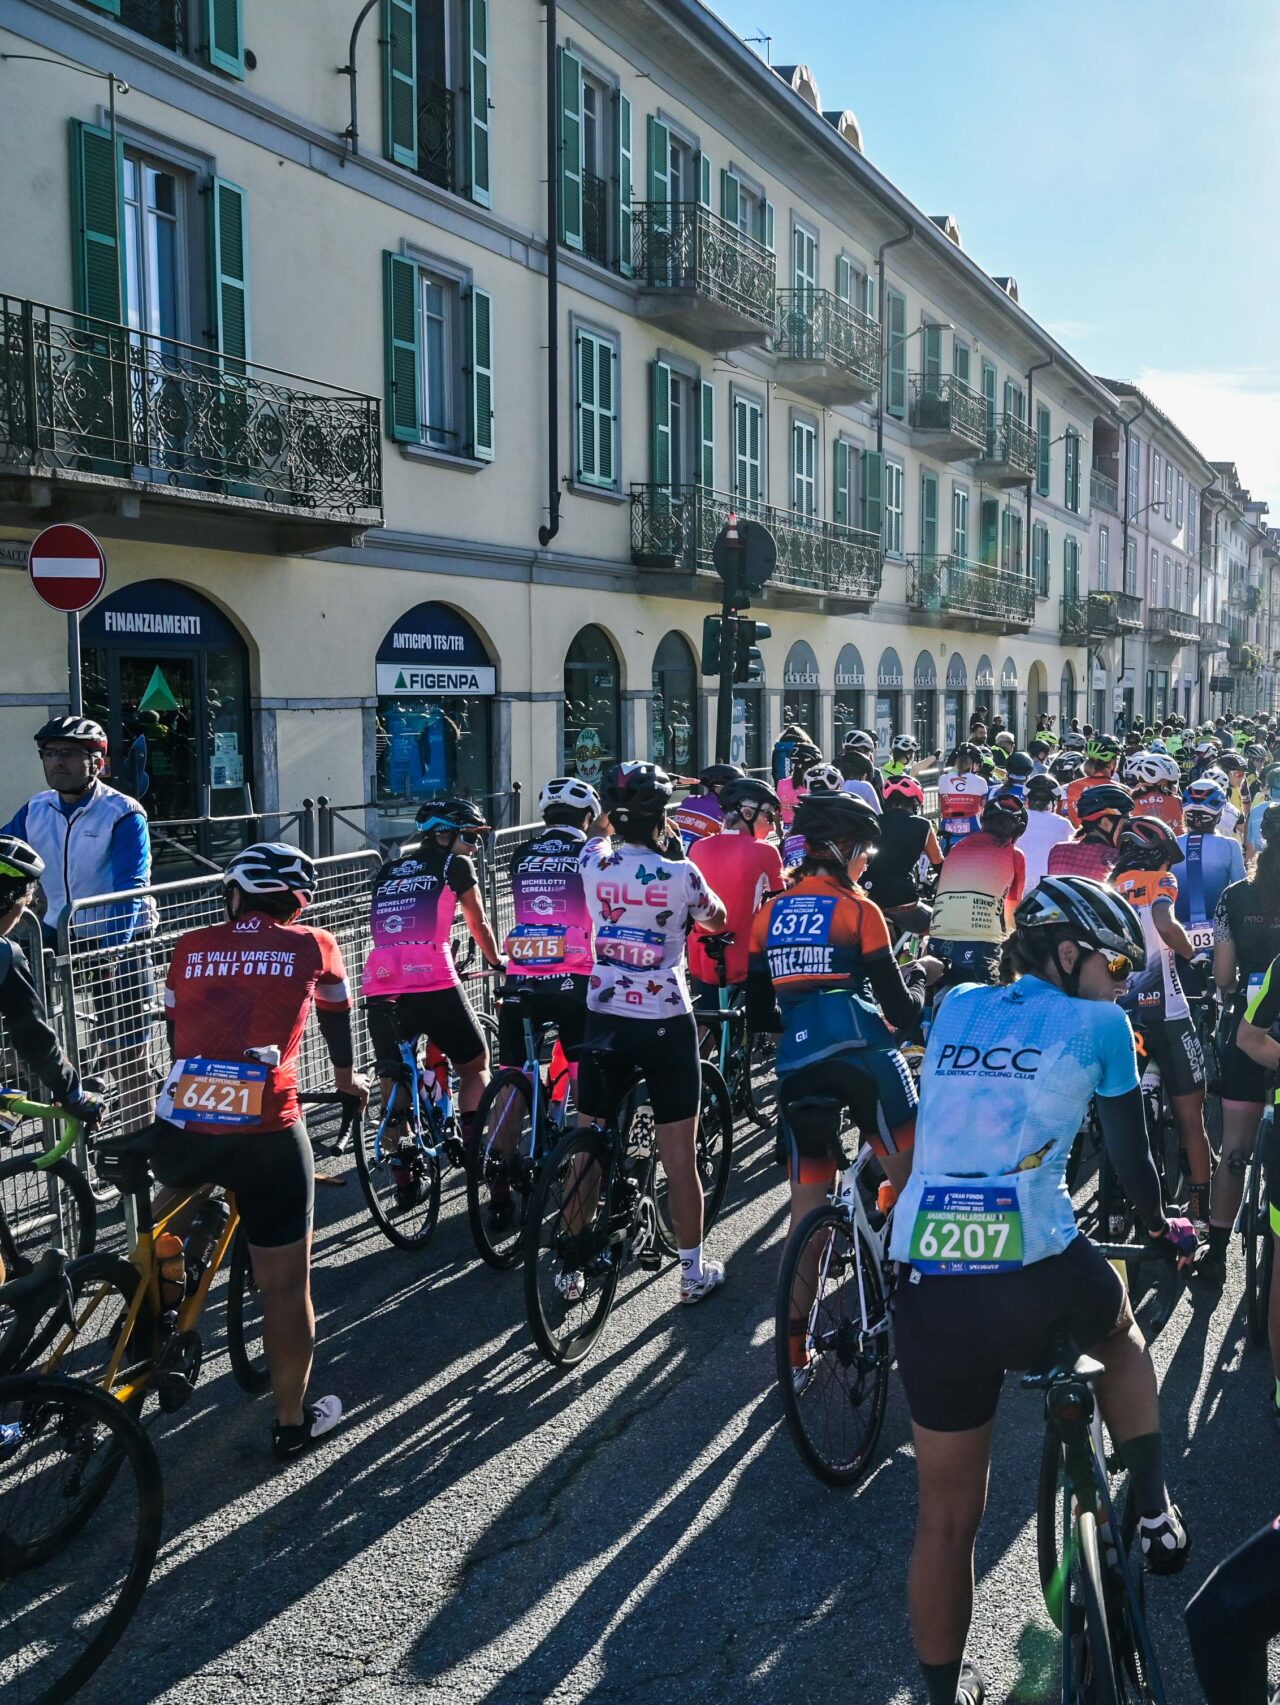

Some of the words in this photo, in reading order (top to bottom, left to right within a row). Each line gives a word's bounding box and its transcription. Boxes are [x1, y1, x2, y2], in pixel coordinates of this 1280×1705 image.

[104, 611, 201, 635] FINANZIAMENTI
[393, 632, 432, 650] ANTICIPO
[433, 635, 465, 651] TFS/TFR
[410, 673, 480, 689] FIGENPA
[785, 662, 820, 684] dorelan
[836, 663, 865, 685] dorelan
[517, 862, 579, 873] PERIN
[376, 881, 433, 897] PERINI
[521, 878, 566, 886] MICHELOTTI
[521, 885, 551, 893] CEREALI
[376, 906, 403, 915] CEREALI
[377, 897, 417, 907] MICHELOTTI
[771, 913, 824, 936] 6312
[187, 951, 204, 964] TRE
[207, 951, 236, 963] VALLI
[241, 951, 297, 964] VARESINE
[512, 940, 558, 958] 6415
[603, 943, 656, 966] 6118
[185, 962, 295, 979] GRANFONDO
[1138, 991, 1161, 1001] RAD
[937, 1044, 1042, 1073] PDCC
[946, 1069, 977, 1077] DISTRICT
[978, 1070, 1012, 1079] CYCLING
[1014, 1072, 1035, 1080] CLUB
[183, 1083, 249, 1113] 6421
[920, 1222, 1010, 1258] 6207
